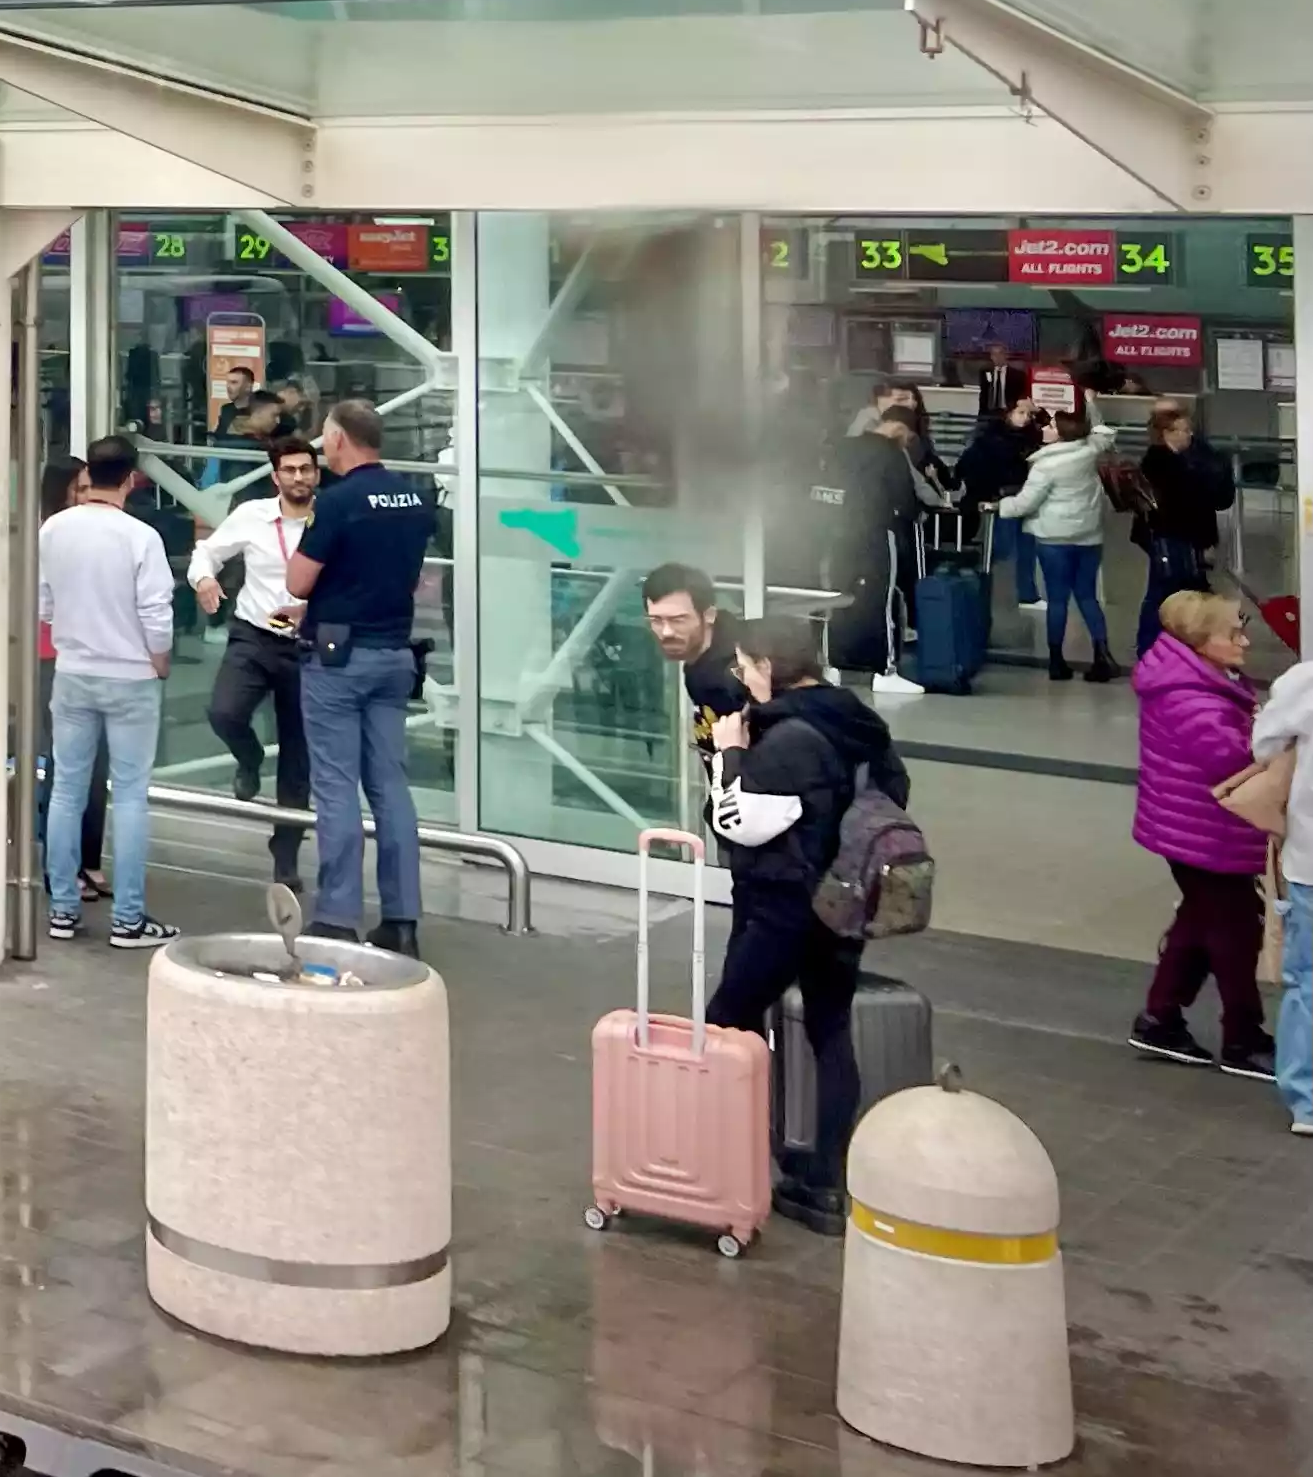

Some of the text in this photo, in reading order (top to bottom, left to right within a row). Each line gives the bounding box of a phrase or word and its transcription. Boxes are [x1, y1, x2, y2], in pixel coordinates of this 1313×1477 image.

[156, 234, 185, 257] 28
[240, 234, 271, 259] 29
[861, 240, 903, 269] 33
[1014, 240, 1110, 256] Jet2.com
[1121, 244, 1170, 273] 34
[1253, 246, 1294, 275] 35
[1021, 263, 1103, 275] ALL FLIGHTS
[1109, 324, 1198, 341] Jet2.com
[1115, 345, 1191, 358] ALL FLIGHTS
[367, 493, 423, 509] POLIZIA
